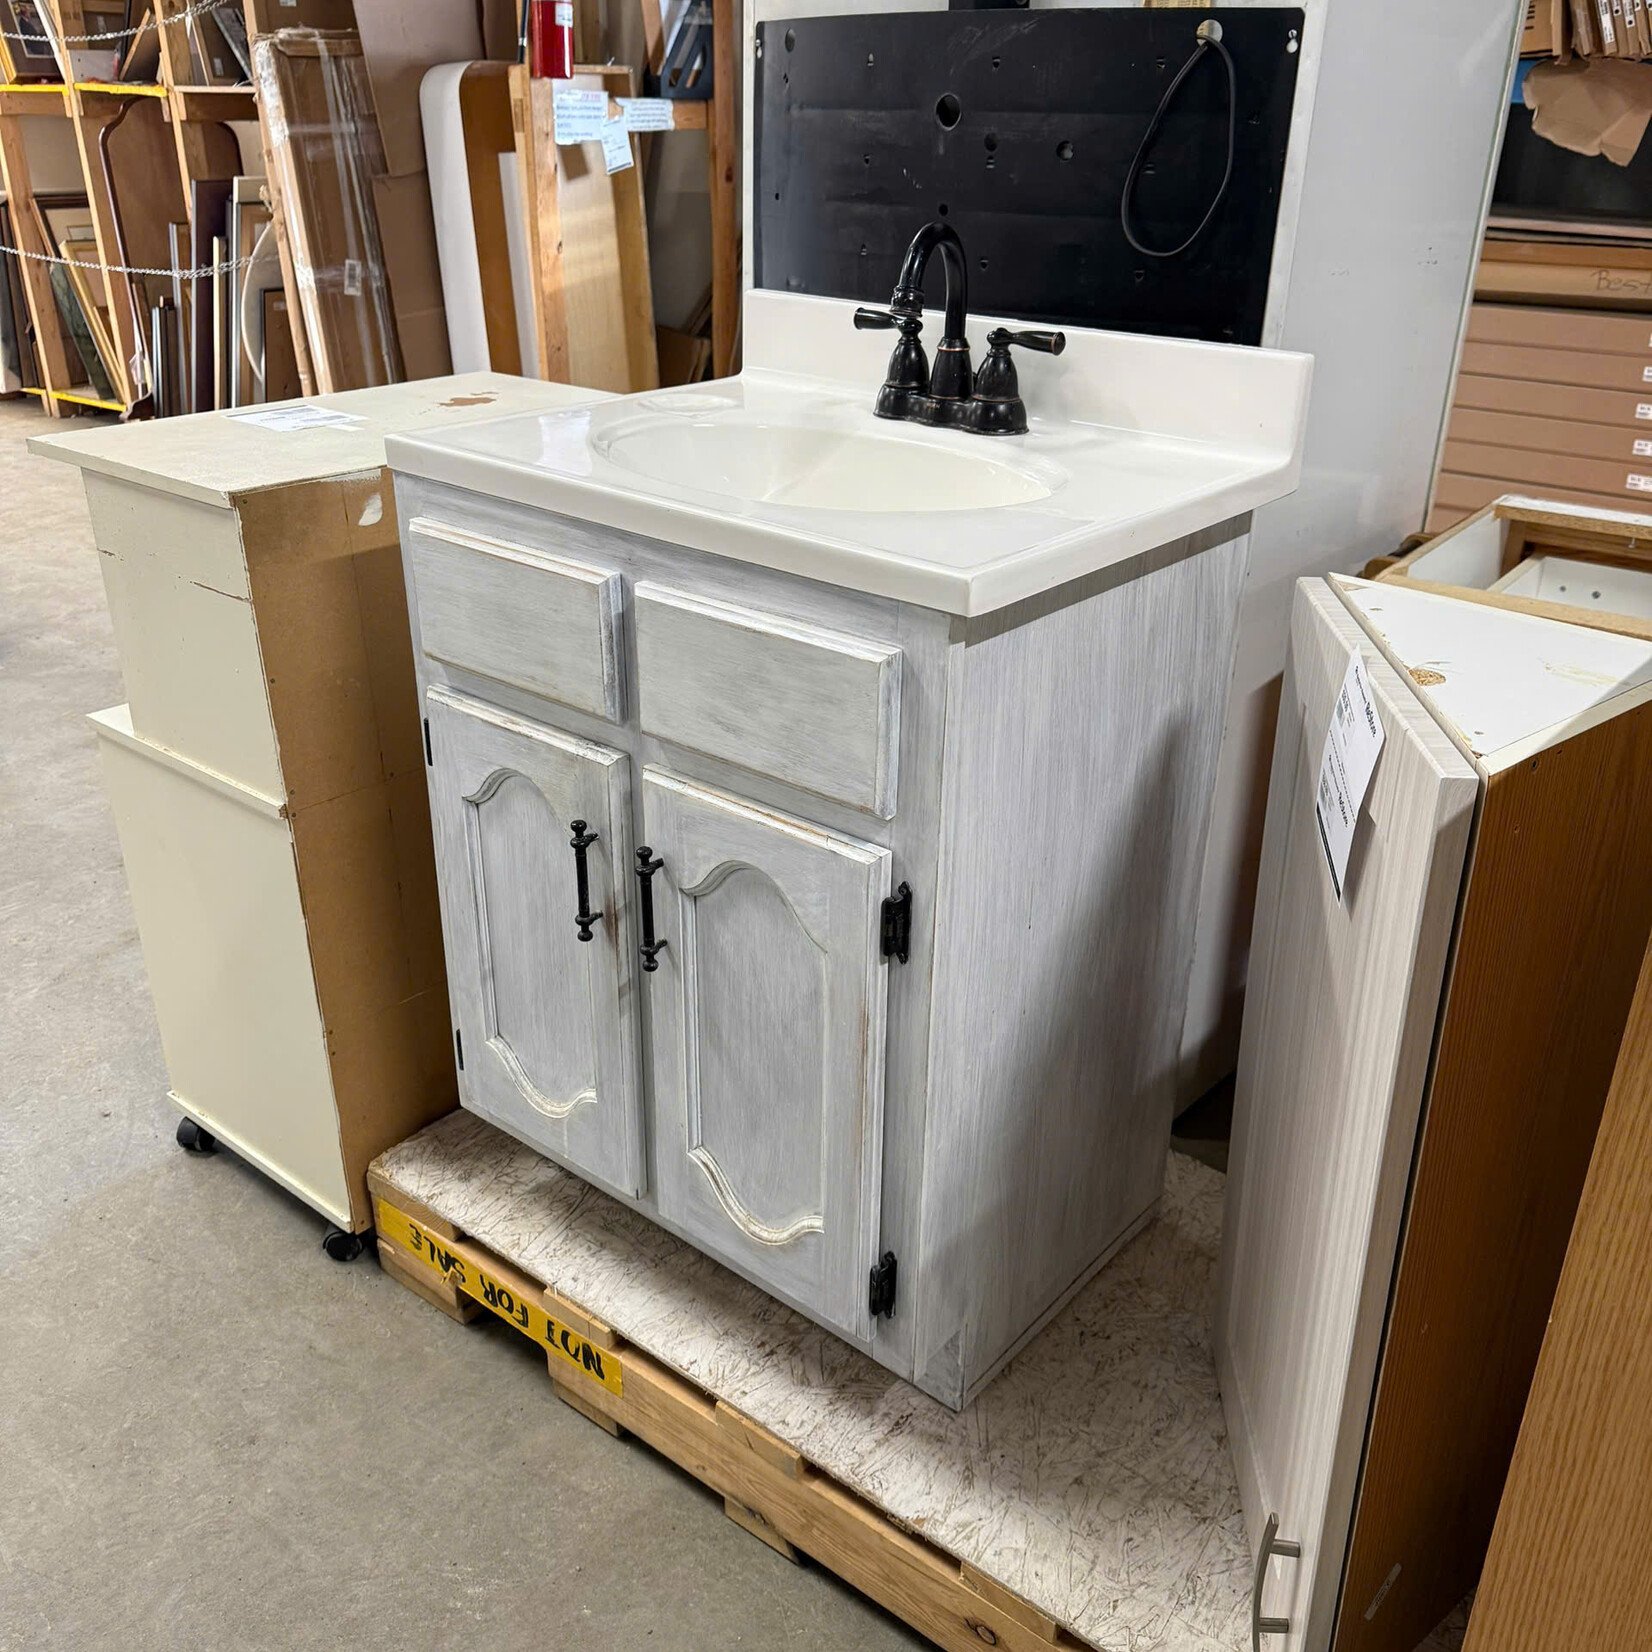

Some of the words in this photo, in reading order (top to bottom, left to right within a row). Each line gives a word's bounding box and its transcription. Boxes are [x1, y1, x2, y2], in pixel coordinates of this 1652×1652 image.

[409, 1223, 467, 1284] SALE
[479, 1274, 529, 1329] FOR
[545, 1319, 605, 1380] NOT
